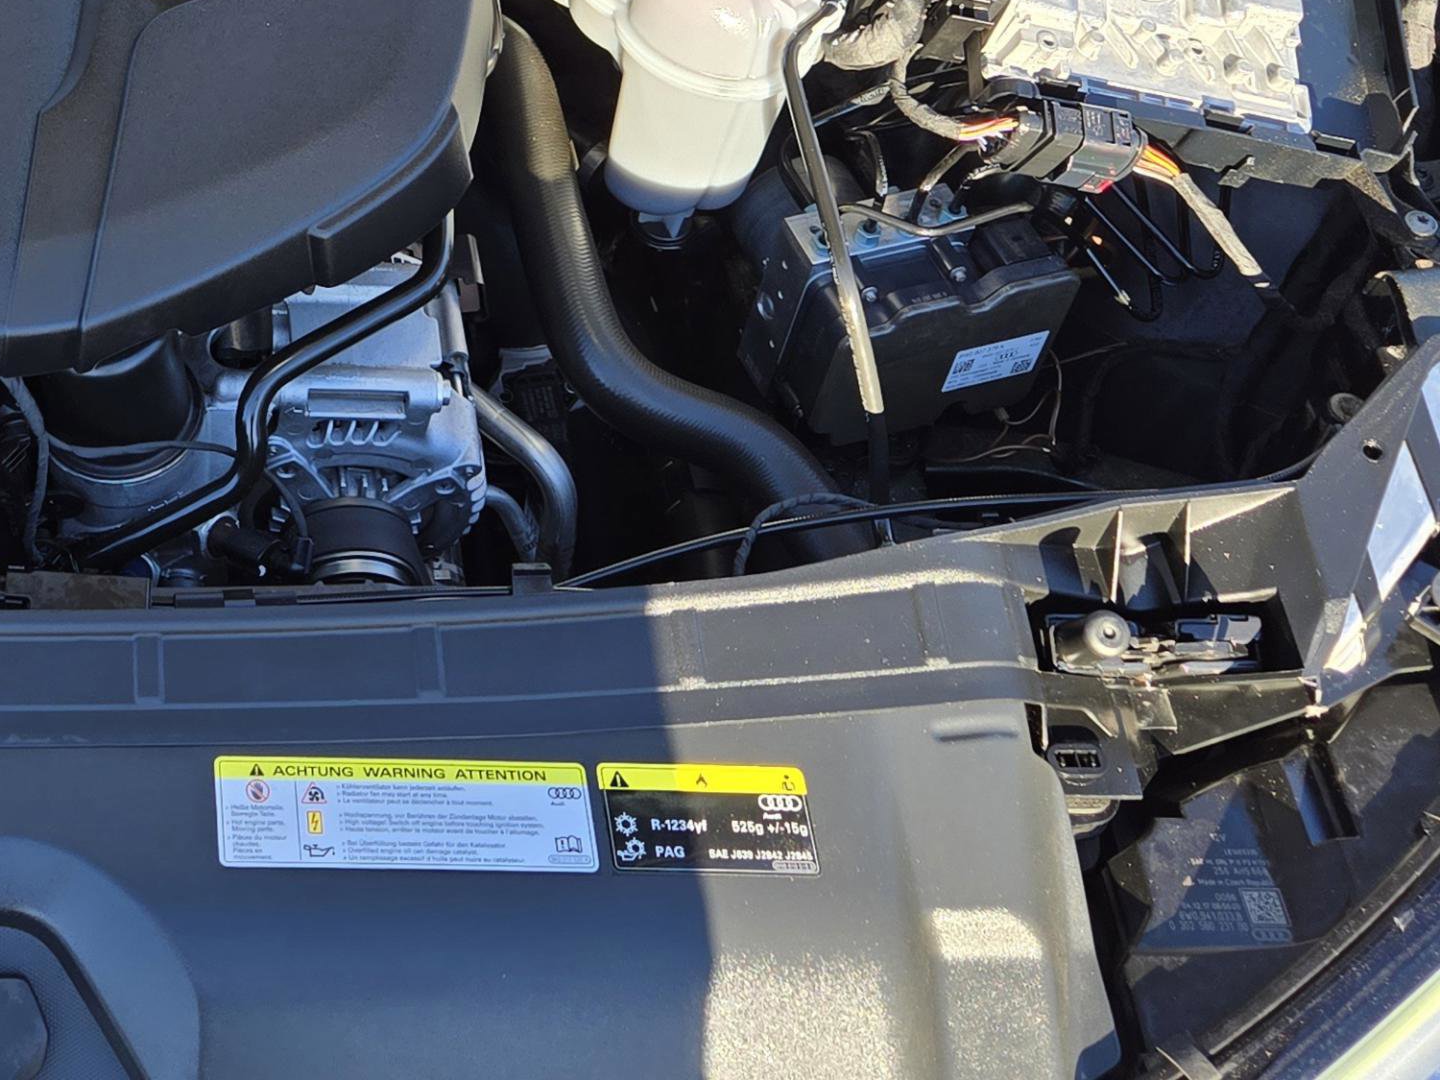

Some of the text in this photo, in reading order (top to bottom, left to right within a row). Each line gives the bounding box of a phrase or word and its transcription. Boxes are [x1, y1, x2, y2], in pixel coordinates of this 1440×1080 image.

[272, 765, 547, 781] ACHTUNG WARNING ATTENTION
[650, 819, 707, 835] R-1234yf
[655, 845, 685, 859] PAG
